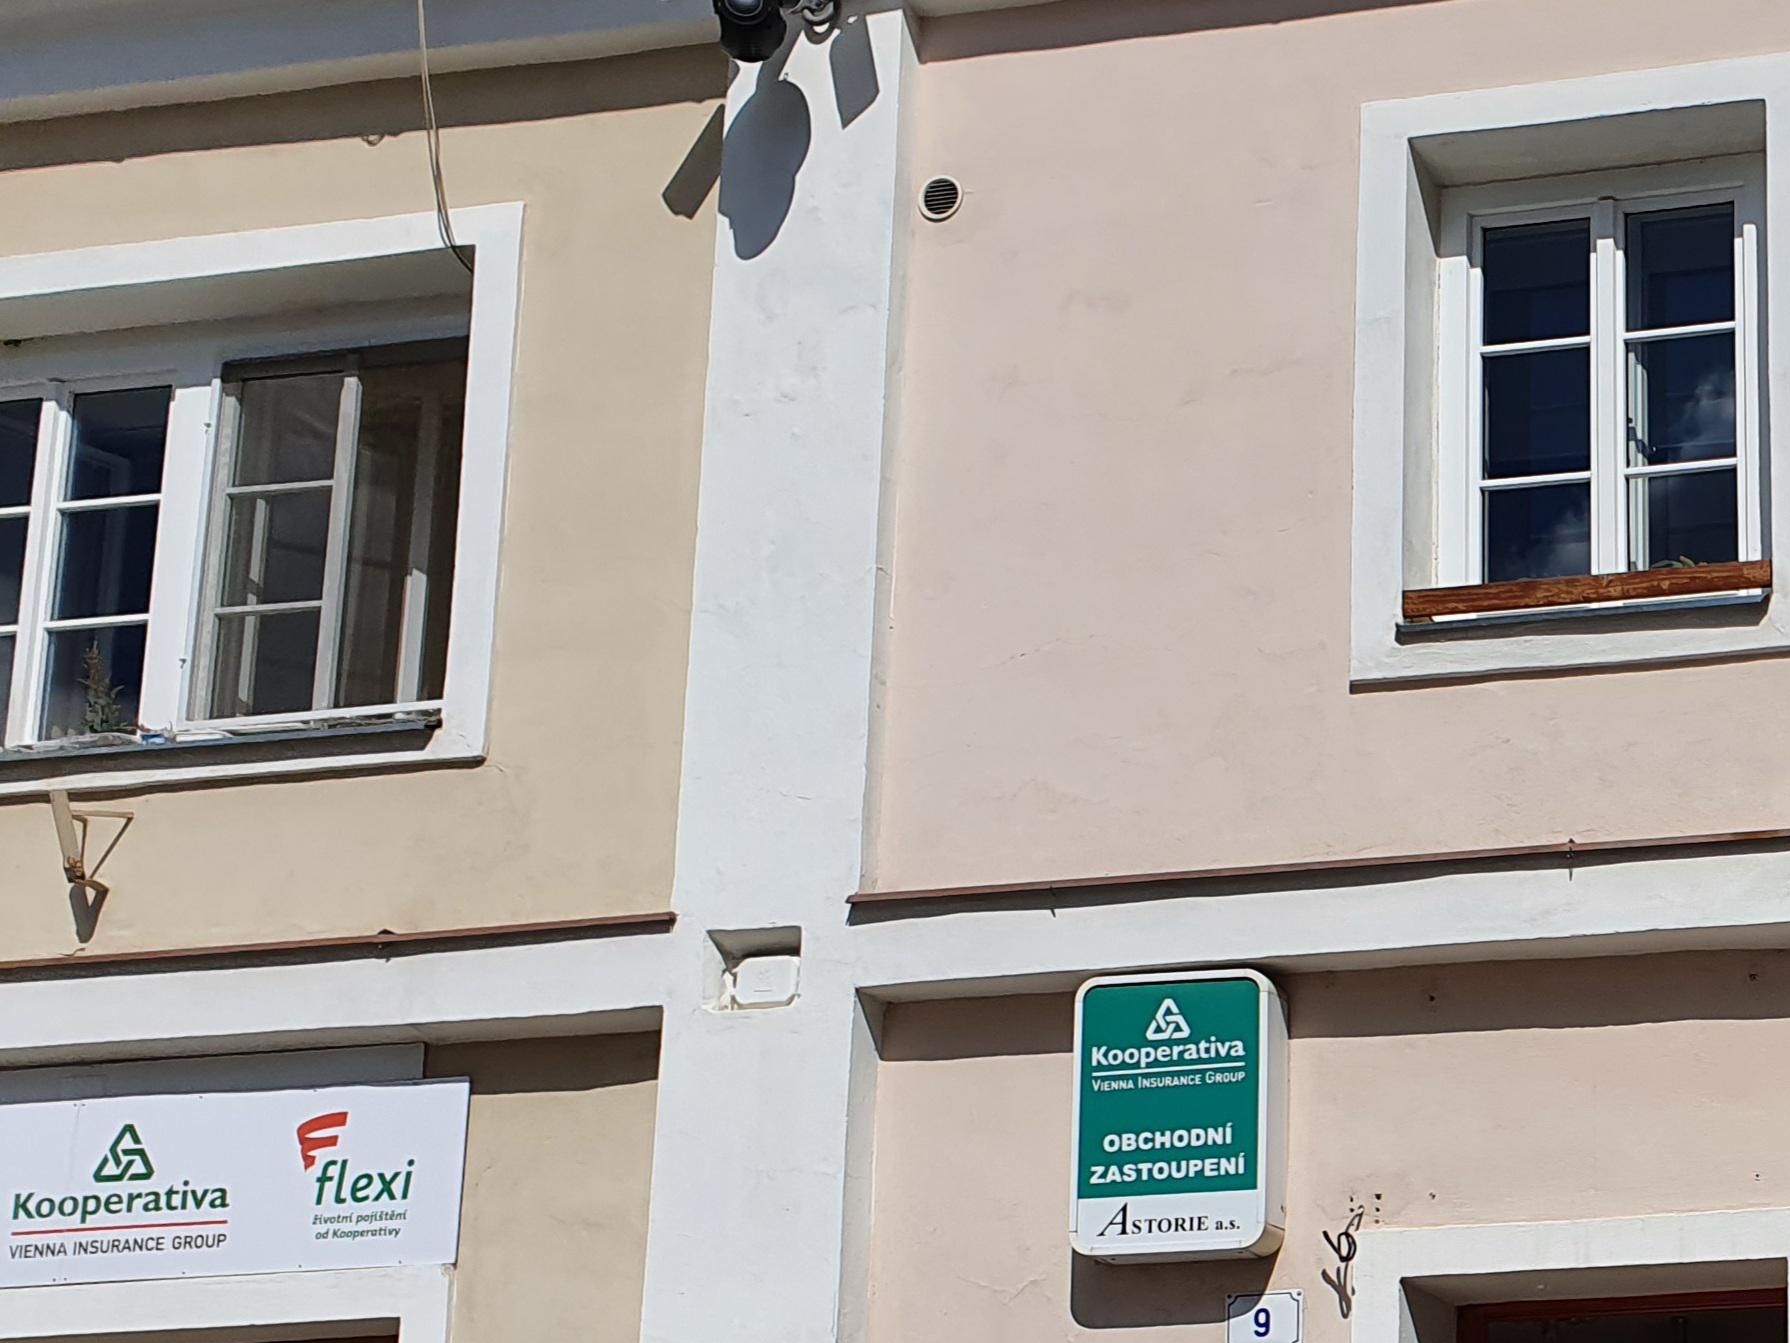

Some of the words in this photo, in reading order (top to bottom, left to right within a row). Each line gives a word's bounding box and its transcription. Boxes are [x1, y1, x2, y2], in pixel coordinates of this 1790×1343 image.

[1091, 1036, 1246, 1068] Kooperativa
[1102, 1122, 1233, 1153] OBCHODNÍ
[314, 1158, 416, 1206] flexi
[1088, 1152, 1246, 1184] ZASTOUPENÍ
[12, 1180, 230, 1224] Kooperativa
[312, 1211, 354, 1225] životní
[355, 1209, 408, 1225] pojištění
[314, 1228, 330, 1240] od
[332, 1226, 402, 1240] Kooperativy
[1214, 1218, 1241, 1232] a.s.
[8, 1242, 68, 1260] VIENNA
[72, 1235, 166, 1257] INSURANCE
[171, 1233, 228, 1251] GROUP
[1253, 1307, 1271, 1338] 9
